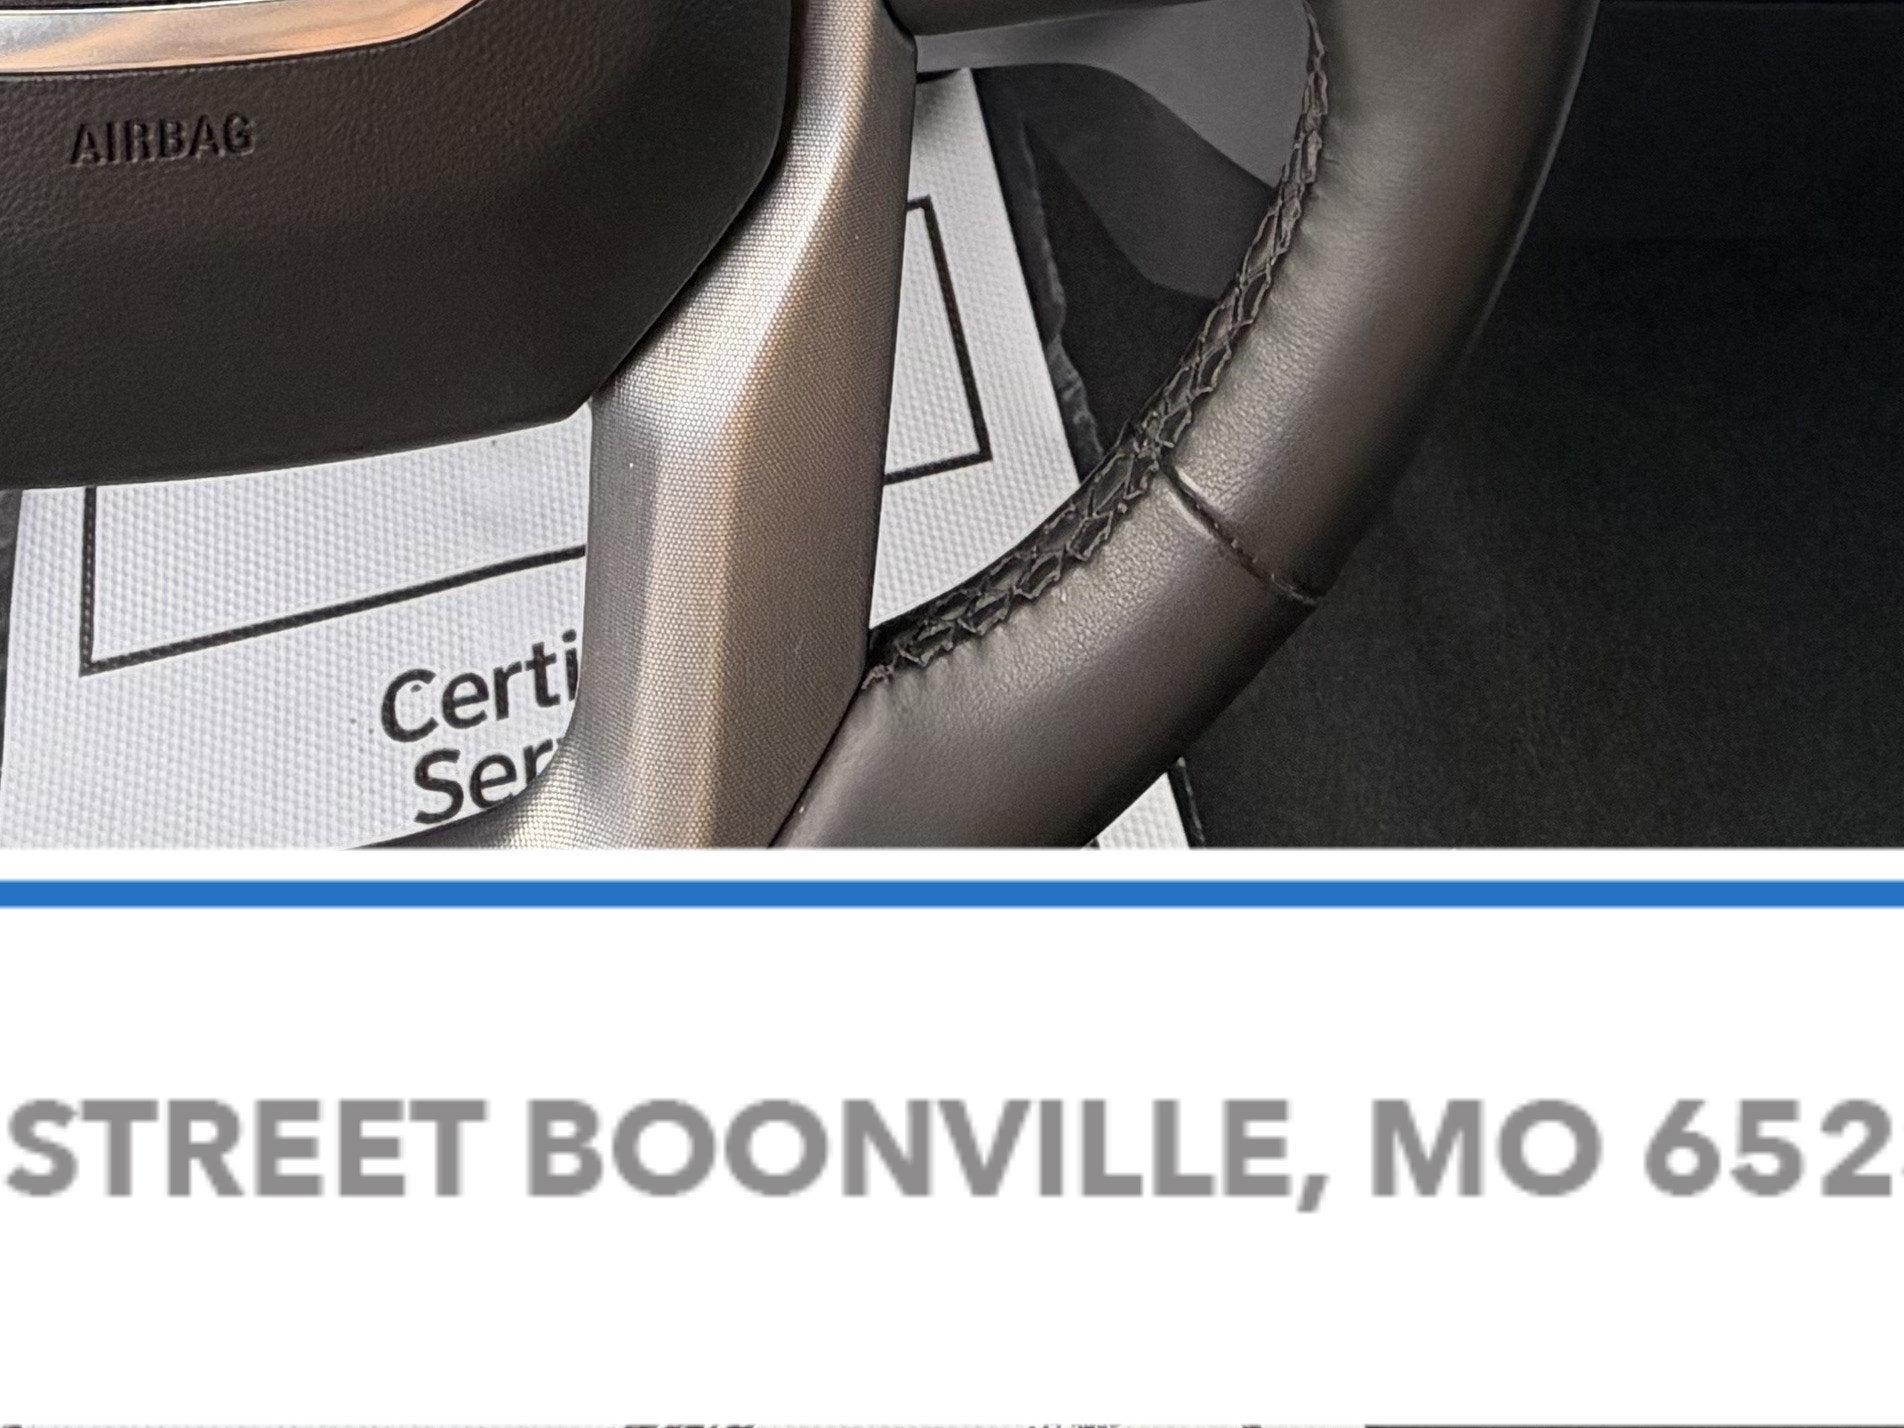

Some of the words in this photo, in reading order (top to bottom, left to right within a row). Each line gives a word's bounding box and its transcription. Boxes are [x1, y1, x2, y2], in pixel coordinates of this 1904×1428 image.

[69, 111, 257, 167] AIRBAG
[380, 628, 579, 744] Certi
[413, 737, 554, 825] Ser
